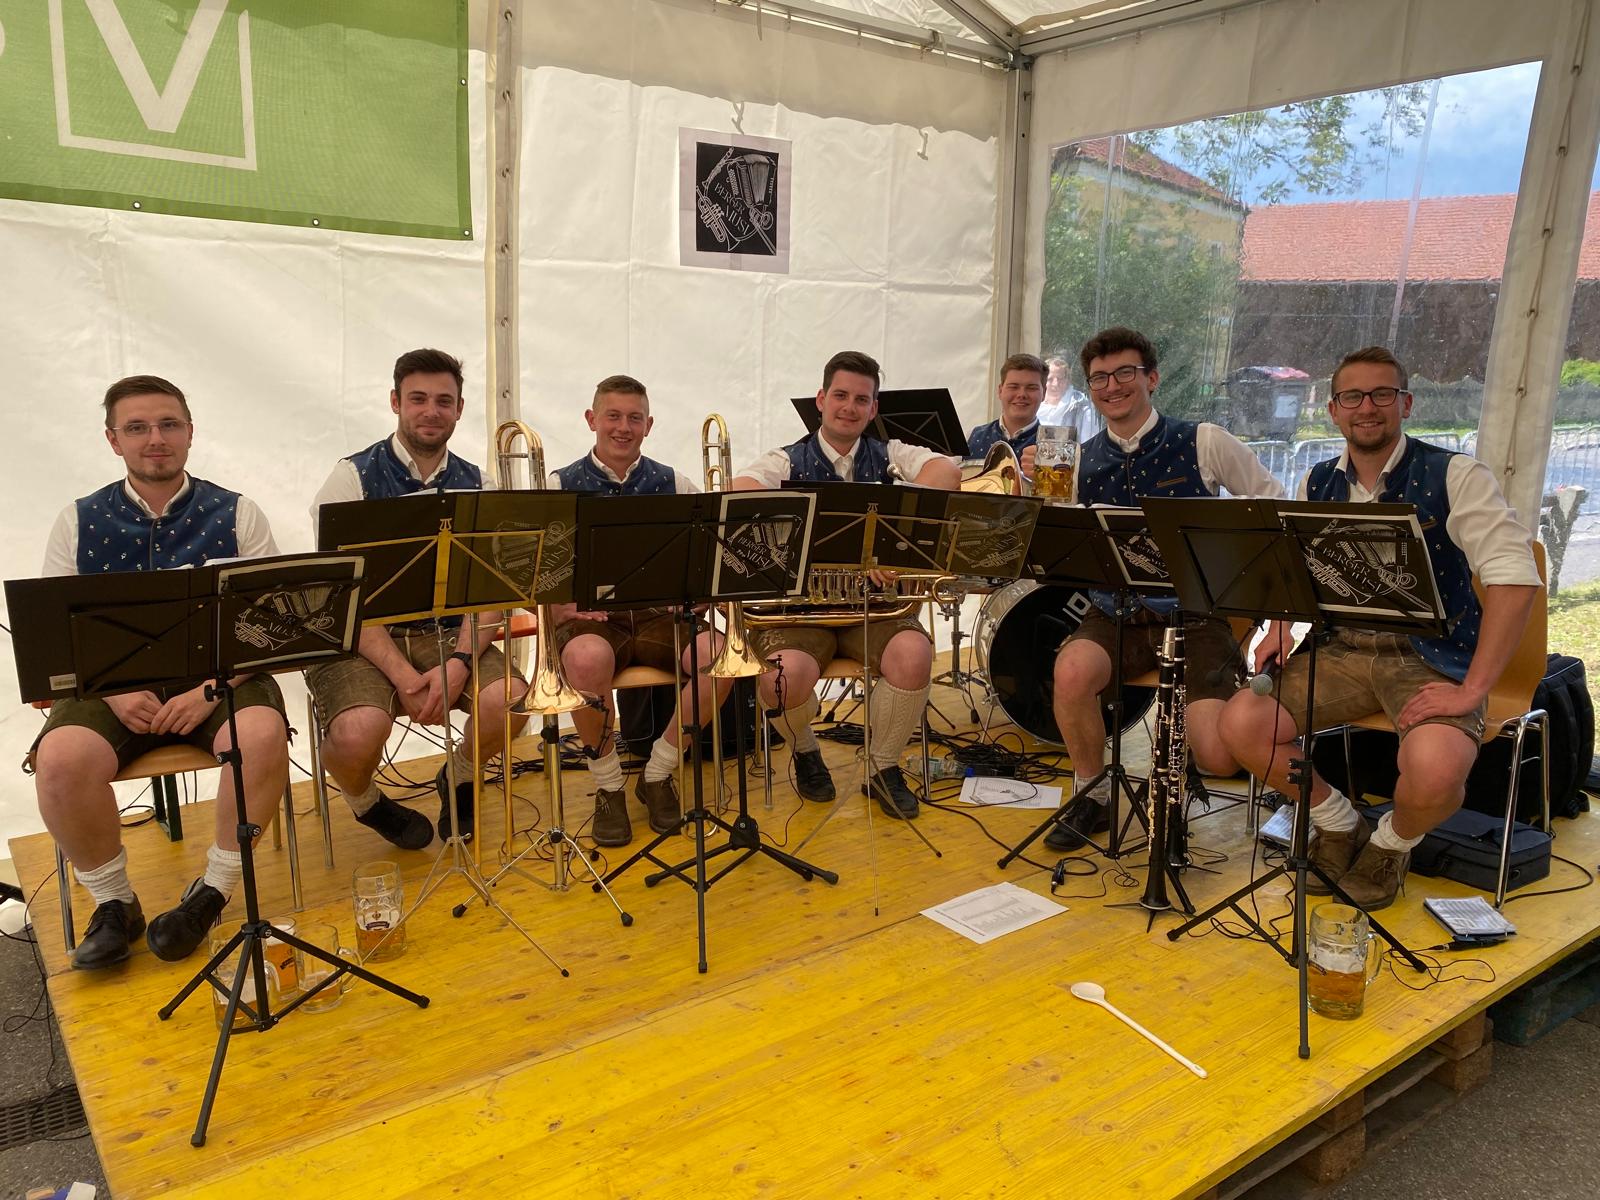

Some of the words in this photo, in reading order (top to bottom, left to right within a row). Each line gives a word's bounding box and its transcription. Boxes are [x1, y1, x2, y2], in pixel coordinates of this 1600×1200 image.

[714, 182, 746, 216] BERGER
[737, 536, 768, 556] BERGER
[1322, 546, 1371, 577] BERGER
